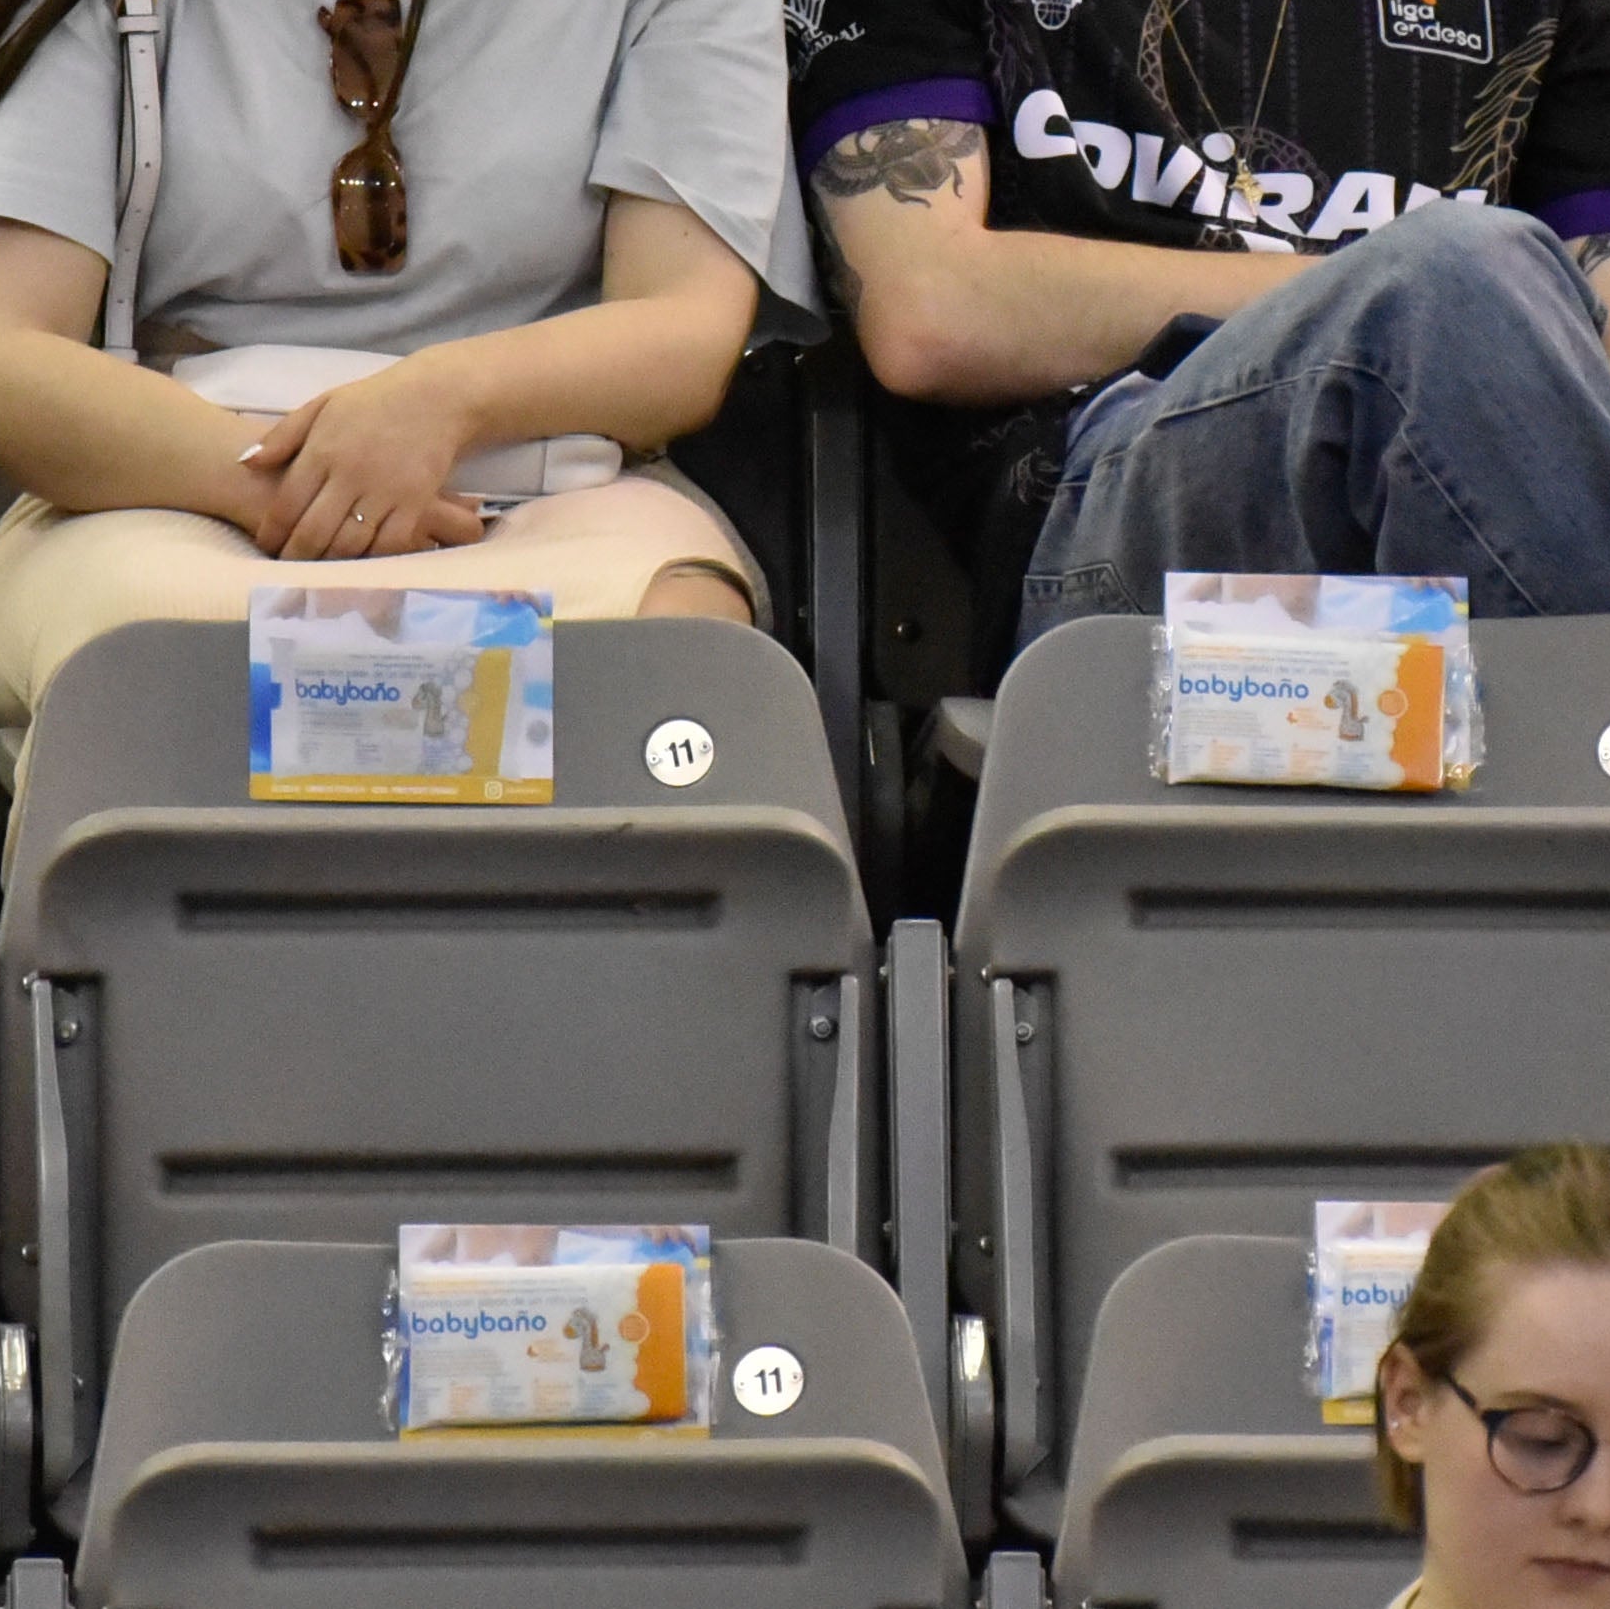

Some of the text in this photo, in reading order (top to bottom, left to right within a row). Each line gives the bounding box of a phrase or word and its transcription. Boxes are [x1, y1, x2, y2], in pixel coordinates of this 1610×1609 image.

[1393, 21, 1482, 51] endesa
[295, 678, 400, 705] babybaño
[1179, 674, 1310, 702] babybaño
[667, 738, 694, 768] 11
[412, 1311, 546, 1339] babybaño
[754, 1367, 783, 1396] 11
